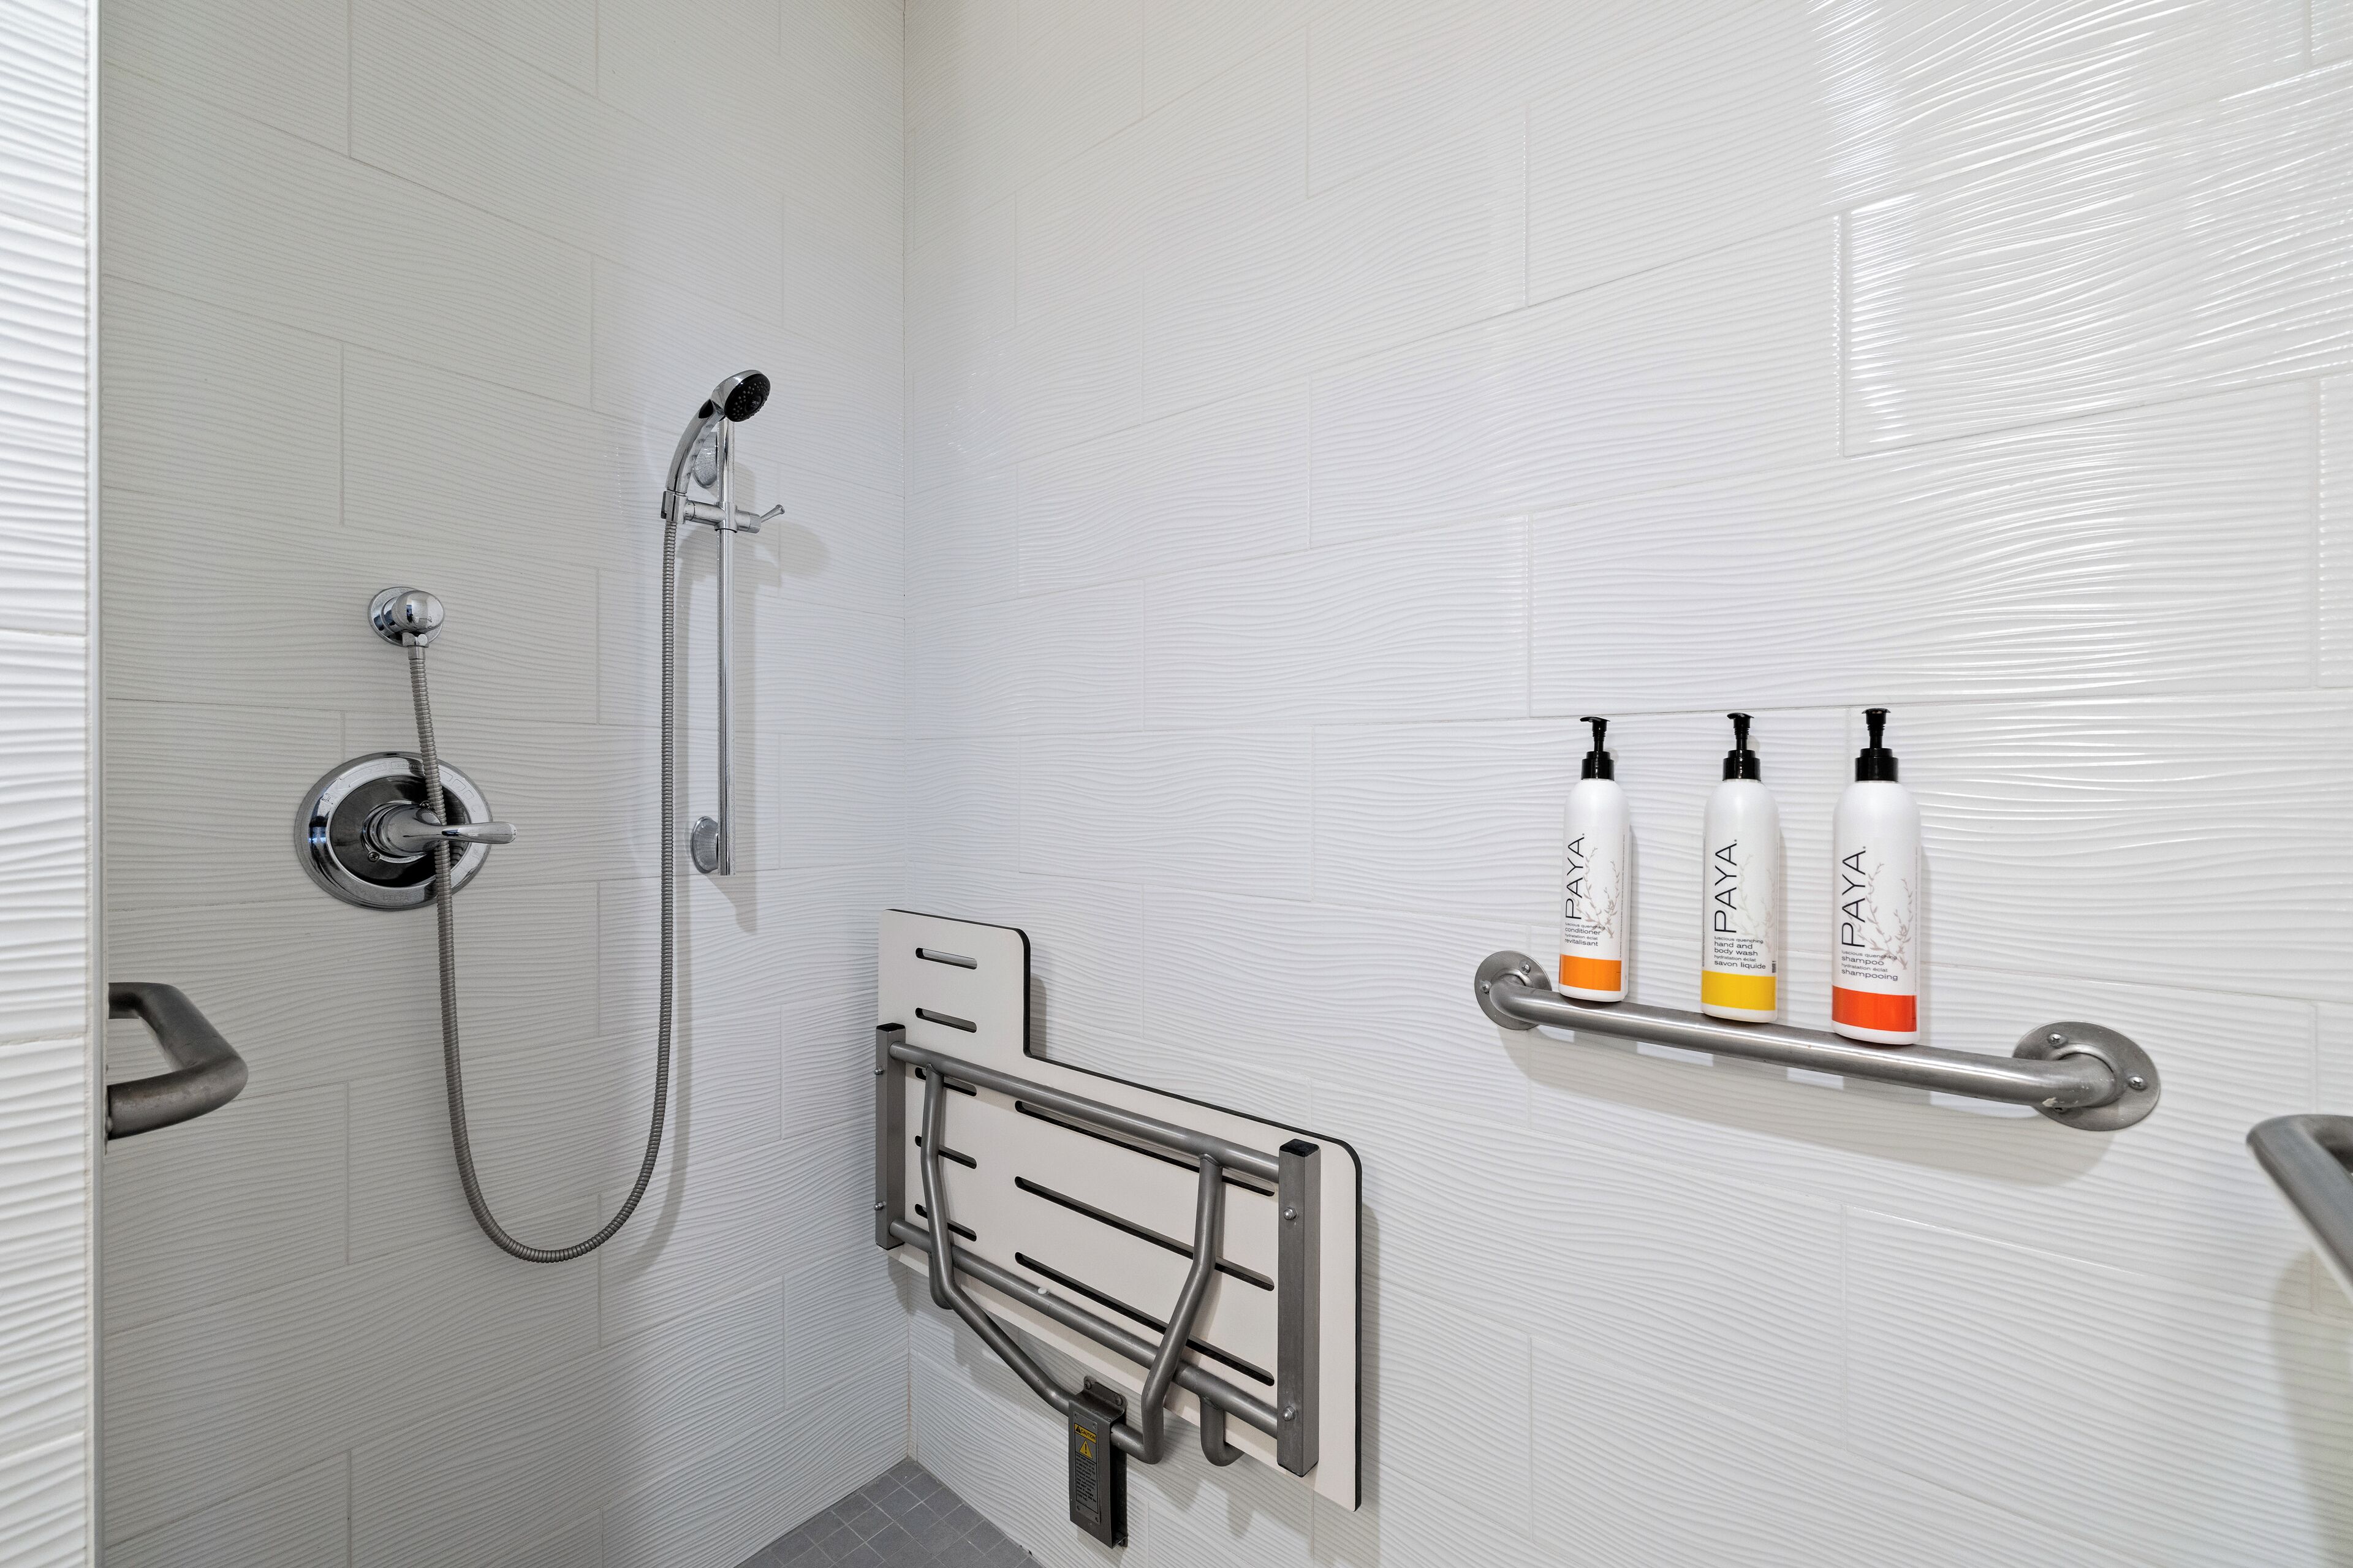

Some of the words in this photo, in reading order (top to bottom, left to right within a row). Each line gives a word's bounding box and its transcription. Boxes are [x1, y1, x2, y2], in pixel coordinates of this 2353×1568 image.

[1841, 956, 1884, 966] shampoo
[1841, 969, 1898, 982] shampooing
[1080, 1429, 1096, 1441] CAUTION
